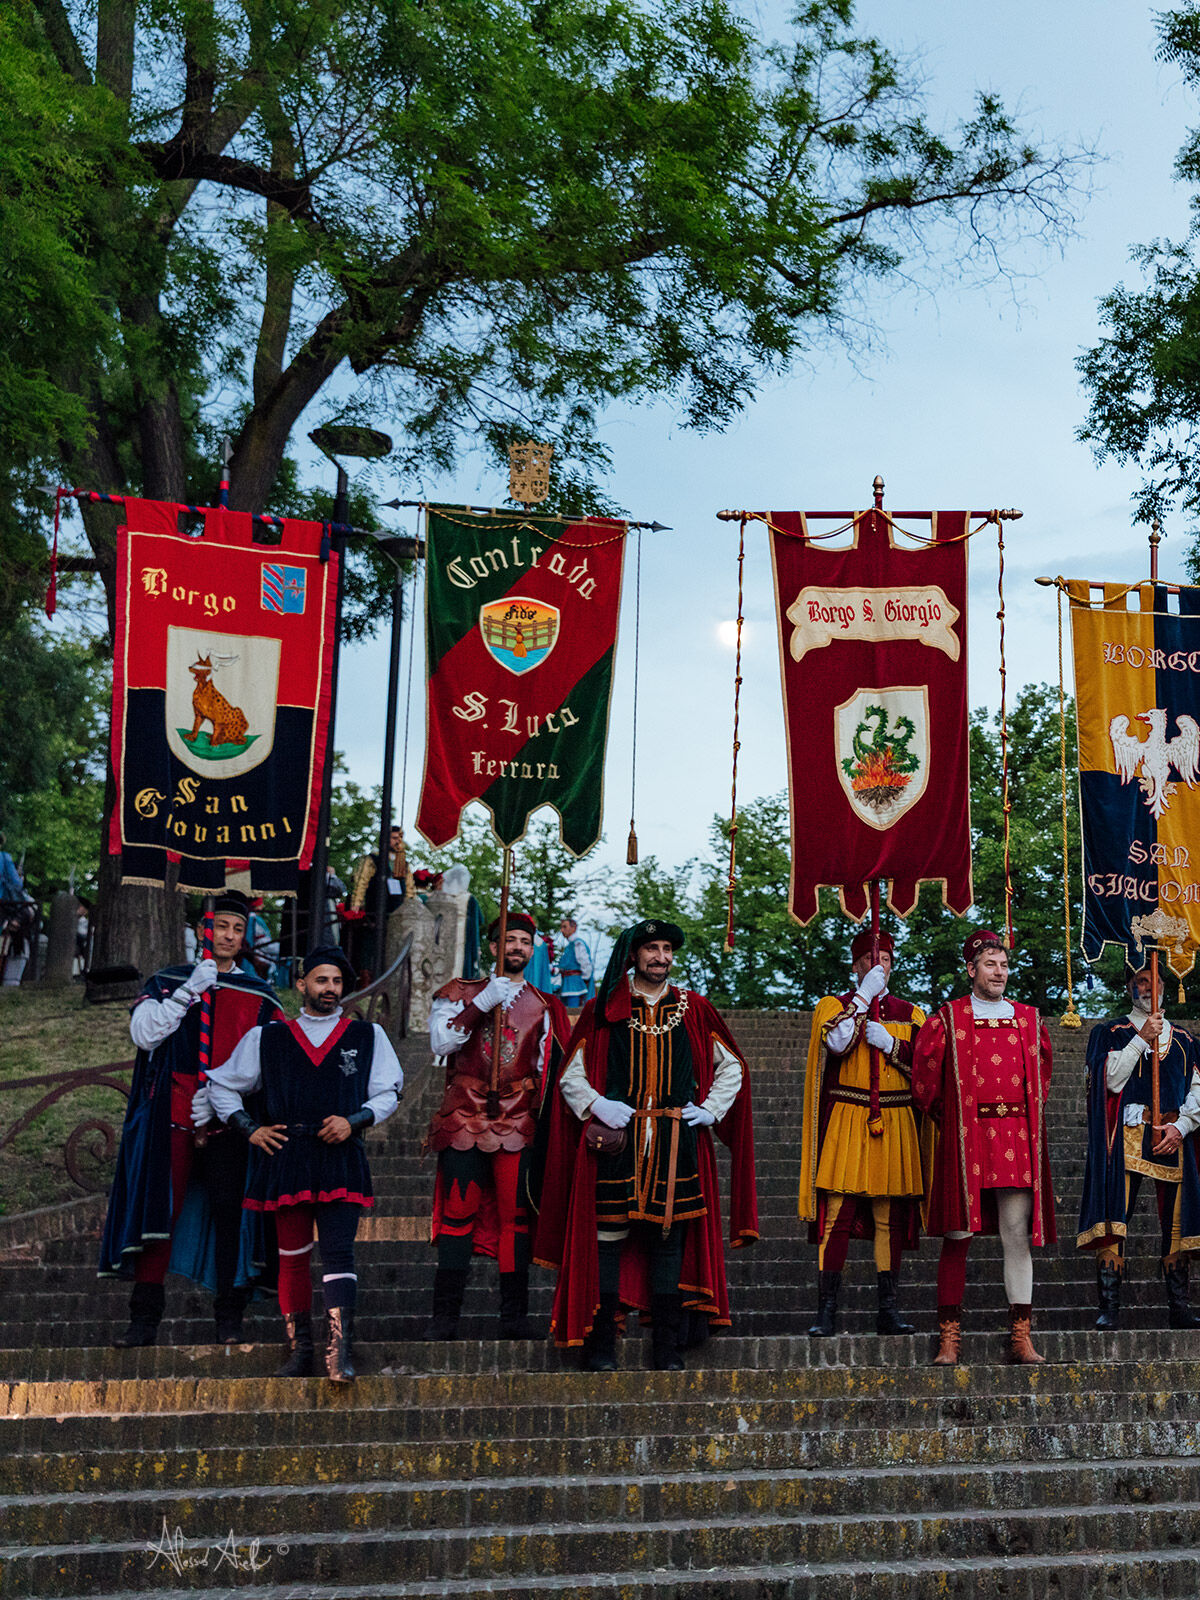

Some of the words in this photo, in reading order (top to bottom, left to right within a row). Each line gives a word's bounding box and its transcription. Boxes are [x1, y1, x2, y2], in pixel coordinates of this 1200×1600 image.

[446, 536, 599, 600] Contrada
[141, 567, 237, 616] Borgo
[807, 600, 855, 629] Borgo
[861, 599, 876, 623] S.
[884, 599, 941, 628] Giorgio
[452, 690, 489, 729] S.
[498, 699, 580, 738] Luca
[471, 750, 561, 780] Ferrara
[134, 788, 292, 843] Giovanni
[172, 777, 249, 814] San
[1127, 840, 1190, 869] SAN
